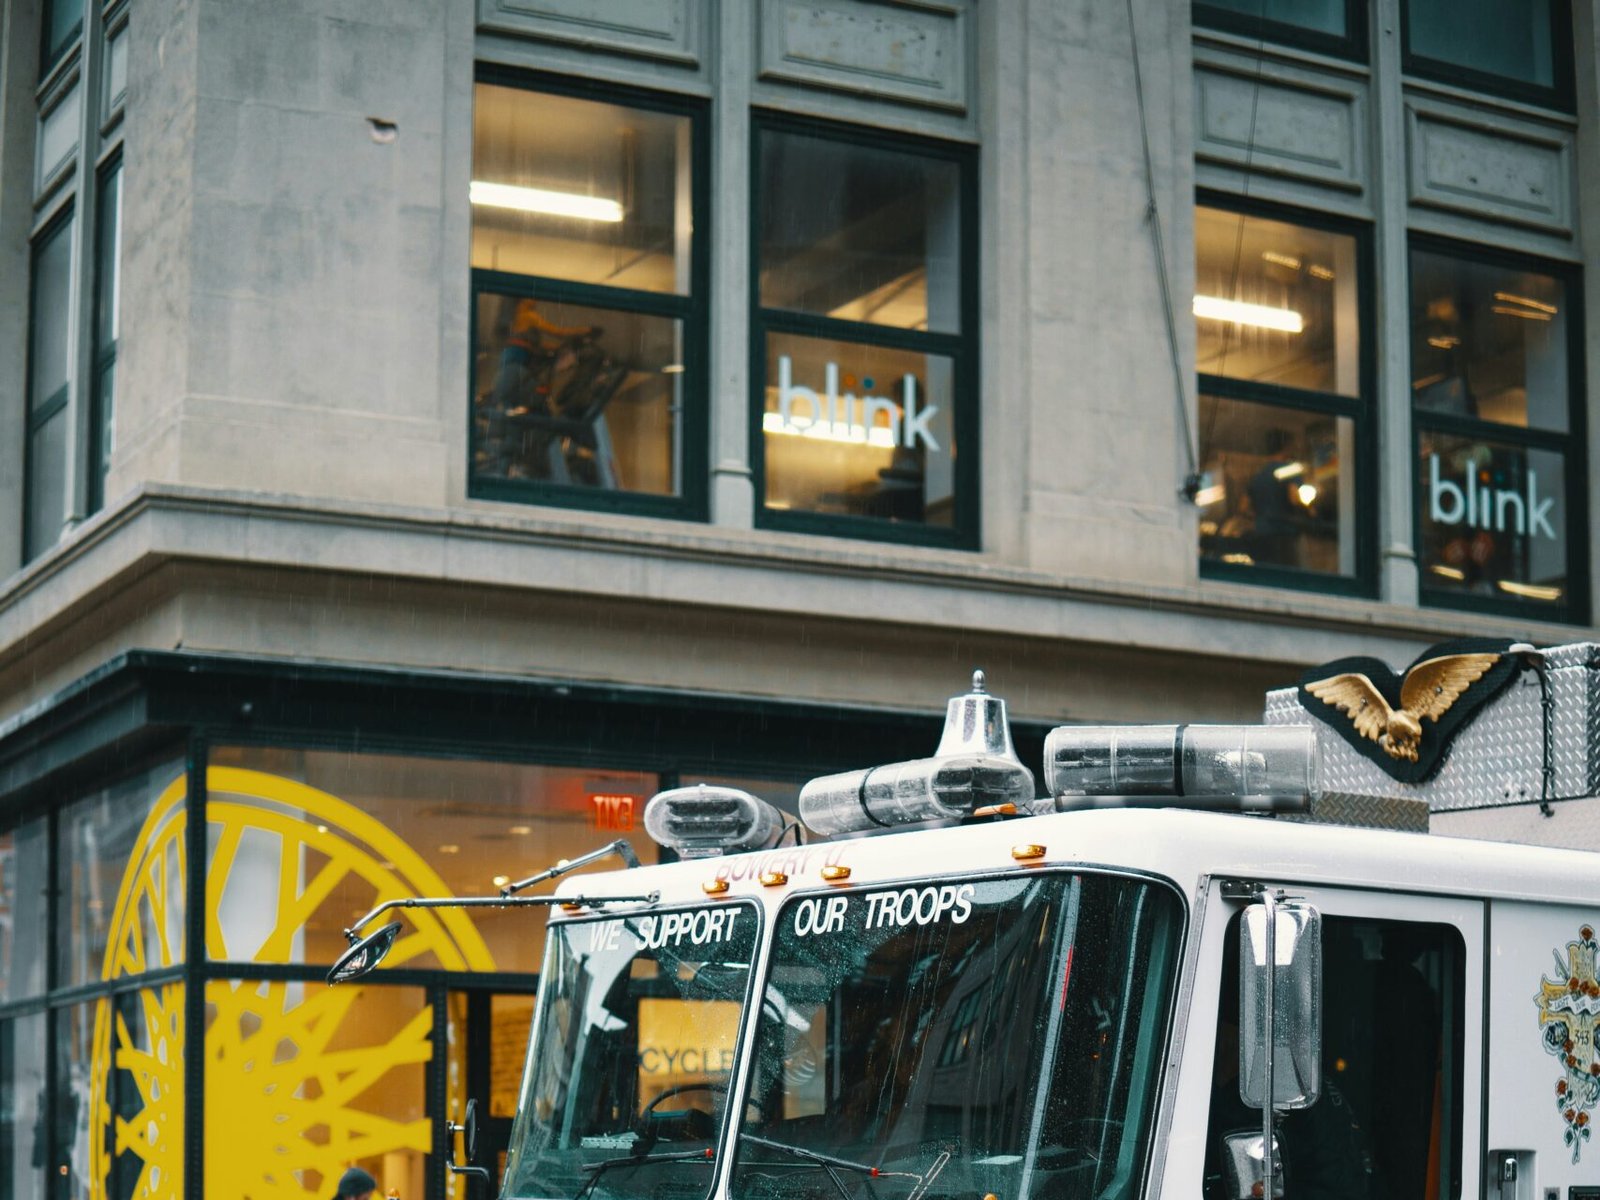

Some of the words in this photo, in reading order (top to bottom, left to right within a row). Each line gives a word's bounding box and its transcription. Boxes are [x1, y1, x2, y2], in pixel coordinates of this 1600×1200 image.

[777, 355, 941, 452] blink
[1430, 452, 1557, 540] blink
[589, 918, 625, 952] WE
[635, 907, 742, 951] SUPPORT
[794, 896, 848, 937] OUR
[865, 884, 975, 930] TROOPS
